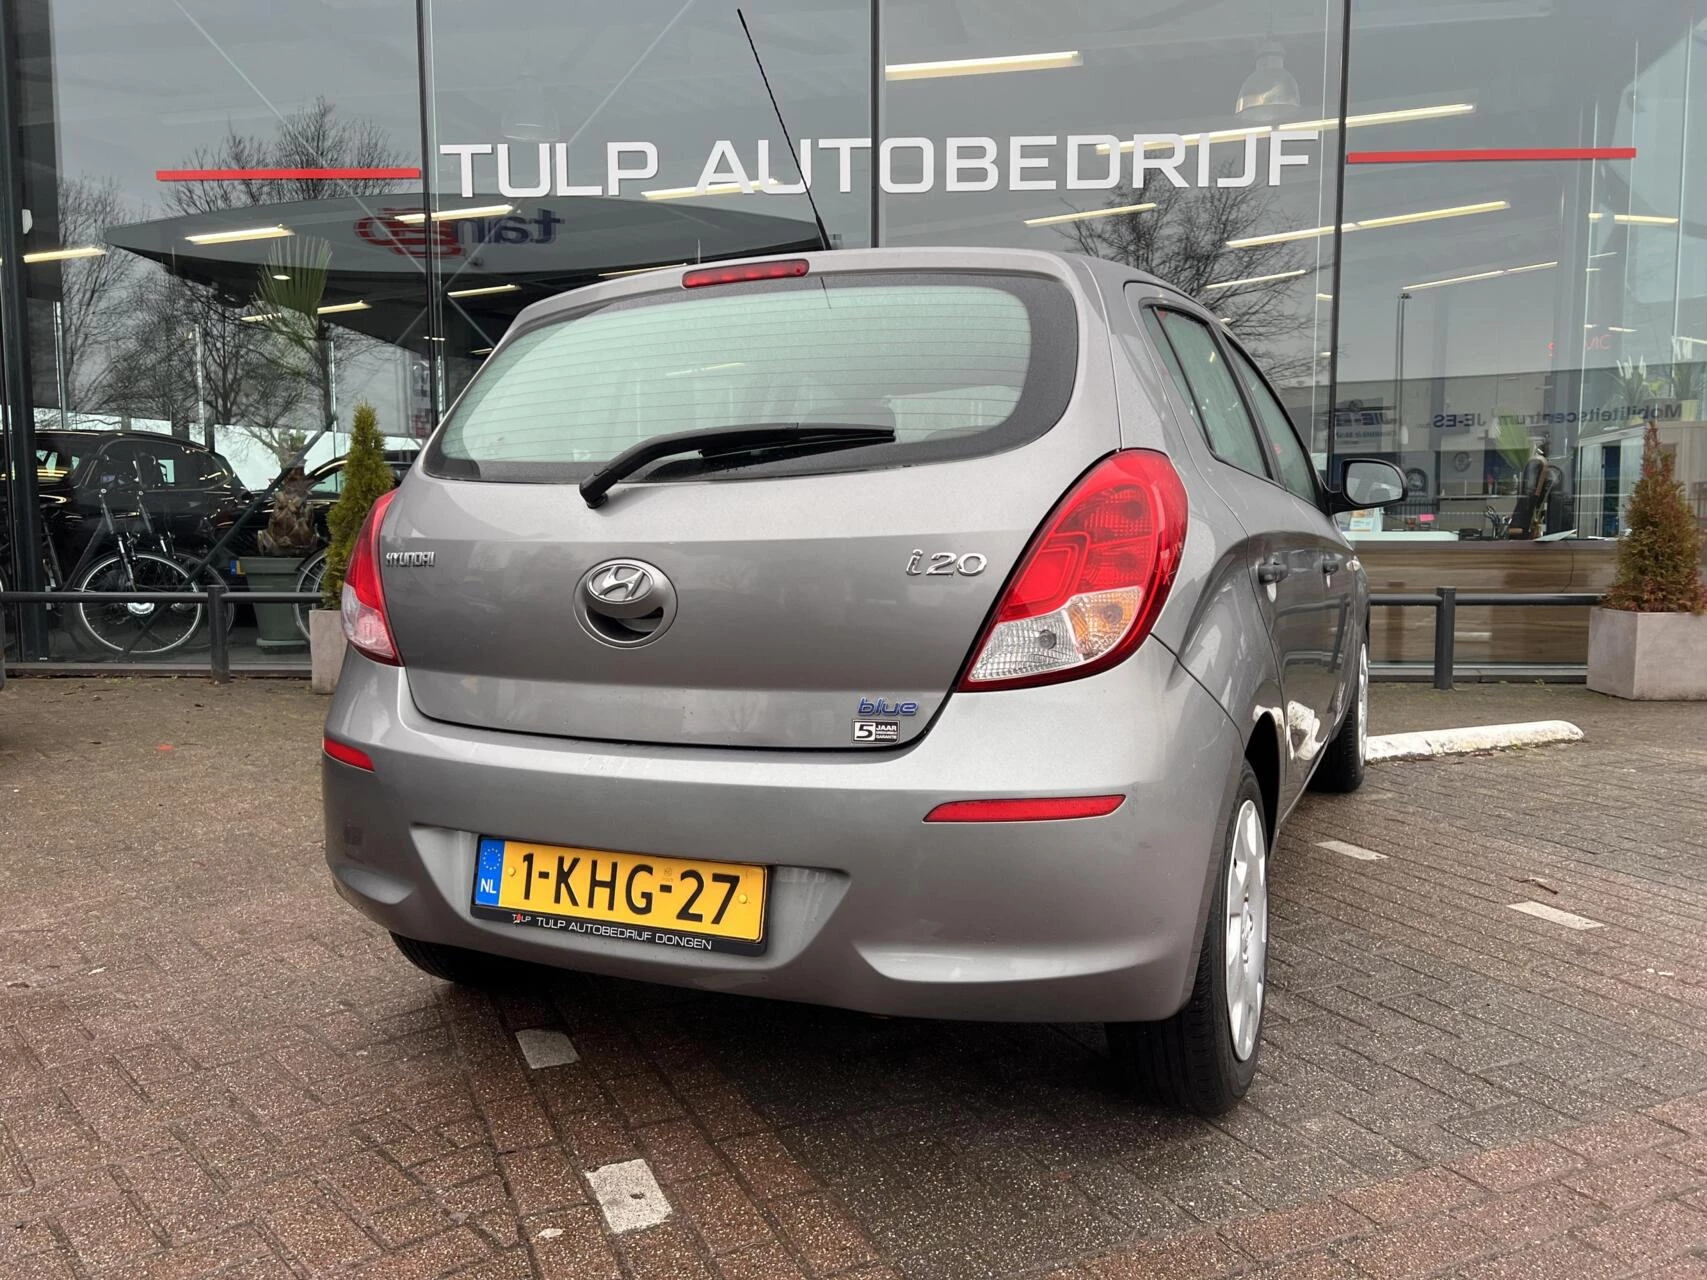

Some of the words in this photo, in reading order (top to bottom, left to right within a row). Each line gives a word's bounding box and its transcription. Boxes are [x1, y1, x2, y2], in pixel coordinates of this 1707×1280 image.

[439, 141, 659, 198] TULP
[695, 130, 1319, 195] AUTOBEDRIJF
[386, 551, 435, 567] HYUNDAI
[906, 548, 988, 577] i20
[858, 696, 919, 716] blue
[855, 723, 874, 739] 5
[480, 878, 497, 895] NL
[522, 852, 741, 925] 1-KHG-27
[536, 917, 566, 929] TULP
[568, 922, 652, 941] AUTOBEDRIJF
[656, 933, 712, 950] DONGEN
